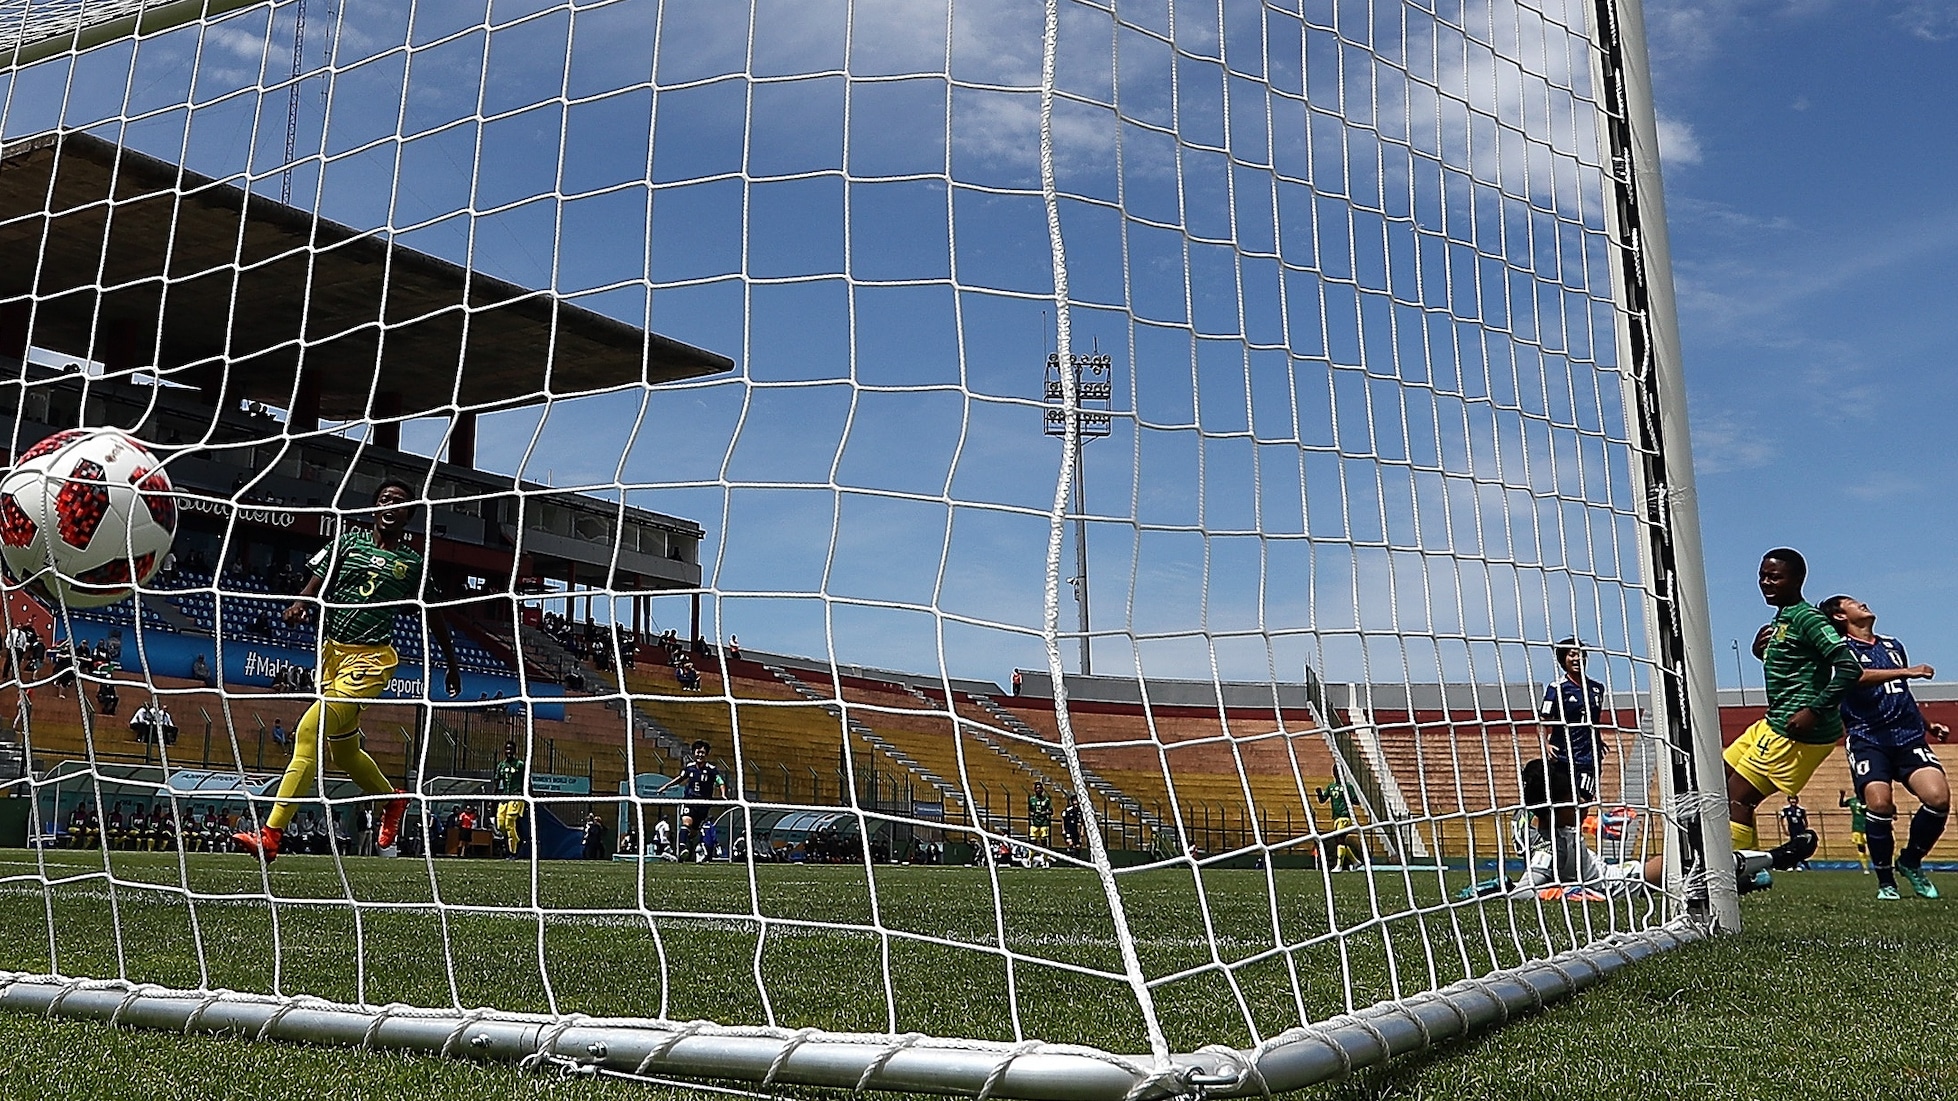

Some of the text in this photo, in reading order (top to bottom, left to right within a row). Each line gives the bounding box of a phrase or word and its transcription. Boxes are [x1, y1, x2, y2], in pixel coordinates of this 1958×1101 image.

[359, 571, 379, 597] 3
[1884, 680, 1904, 694] 12
[1756, 734, 1771, 757] 4
